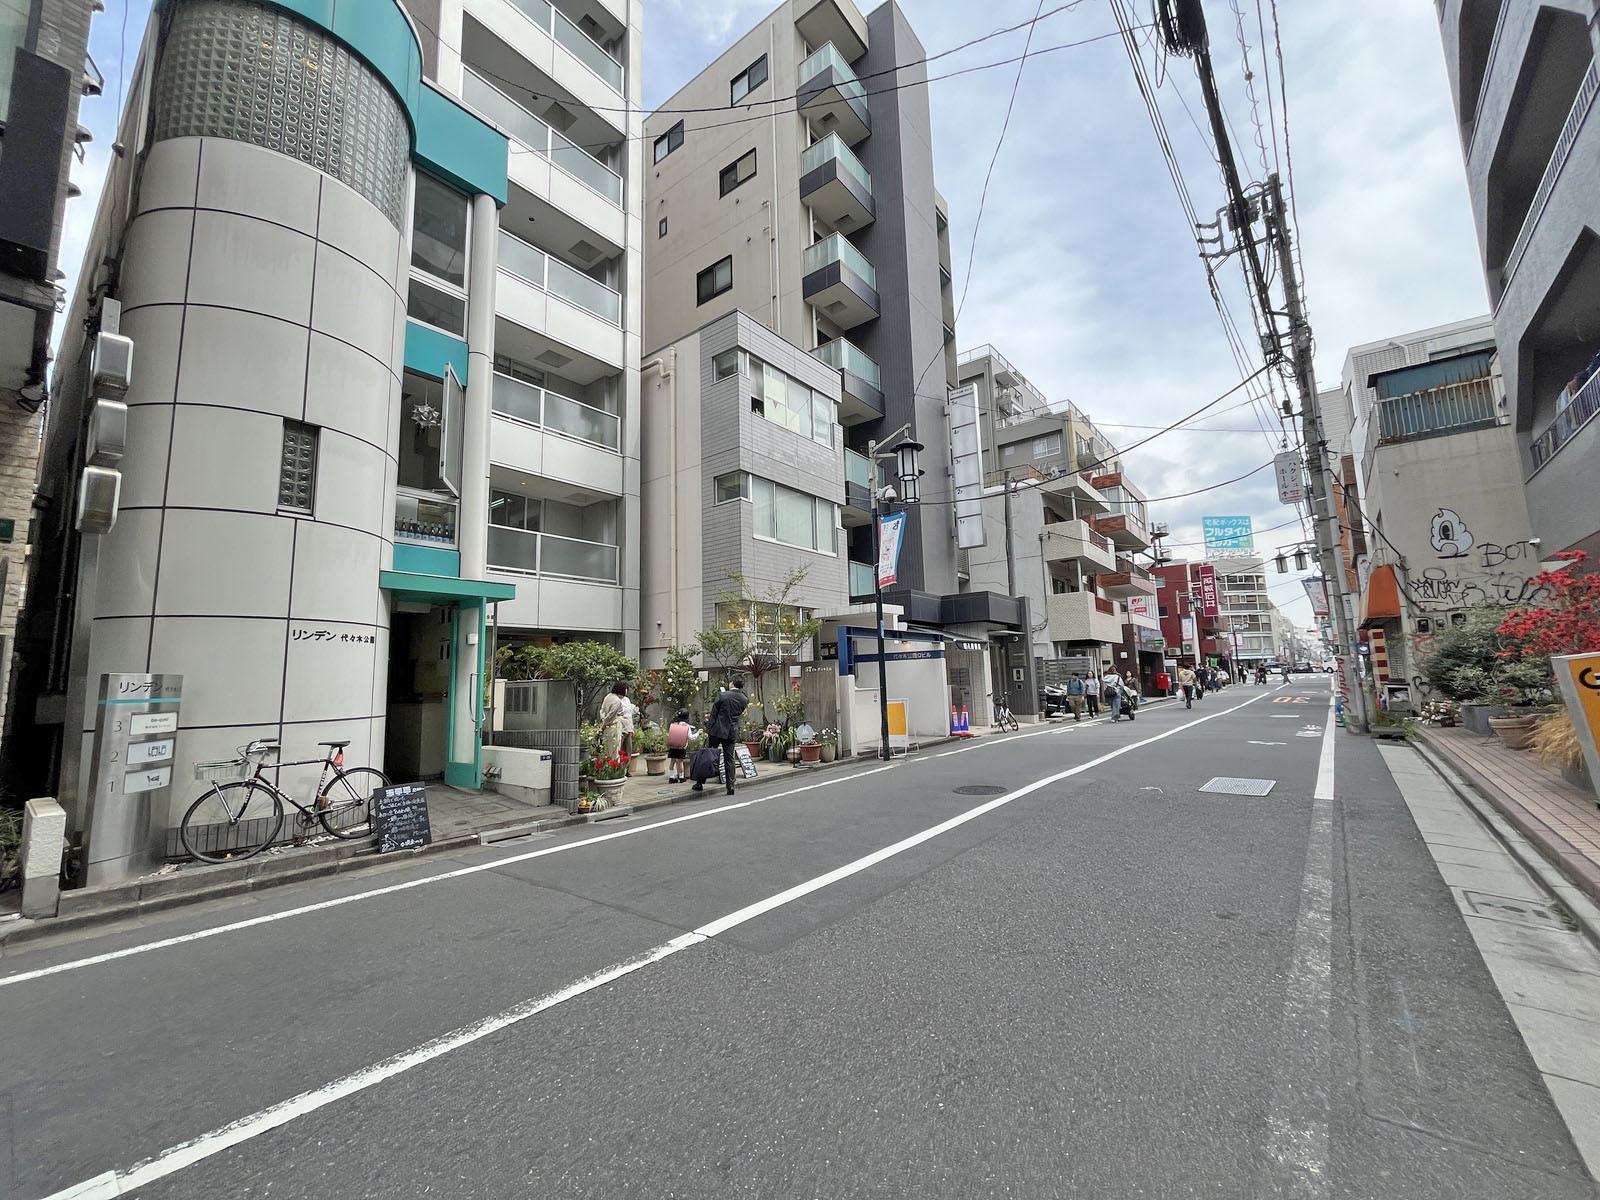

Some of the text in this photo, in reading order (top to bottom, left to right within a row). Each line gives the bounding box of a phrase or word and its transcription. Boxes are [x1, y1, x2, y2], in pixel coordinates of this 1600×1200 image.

[1280, 468, 1289, 489] ホール
[1289, 462, 1299, 488] ハクジュ
[1205, 527, 1251, 537] フルタイム
[1477, 541, 1530, 568] BOT
[292, 629, 375, 644] リンデン 代々木公園
[120, 682, 163, 694] リンデン
[114, 720, 122, 732] 3
[110, 751, 119, 763] 2
[107, 781, 115, 793] 1
